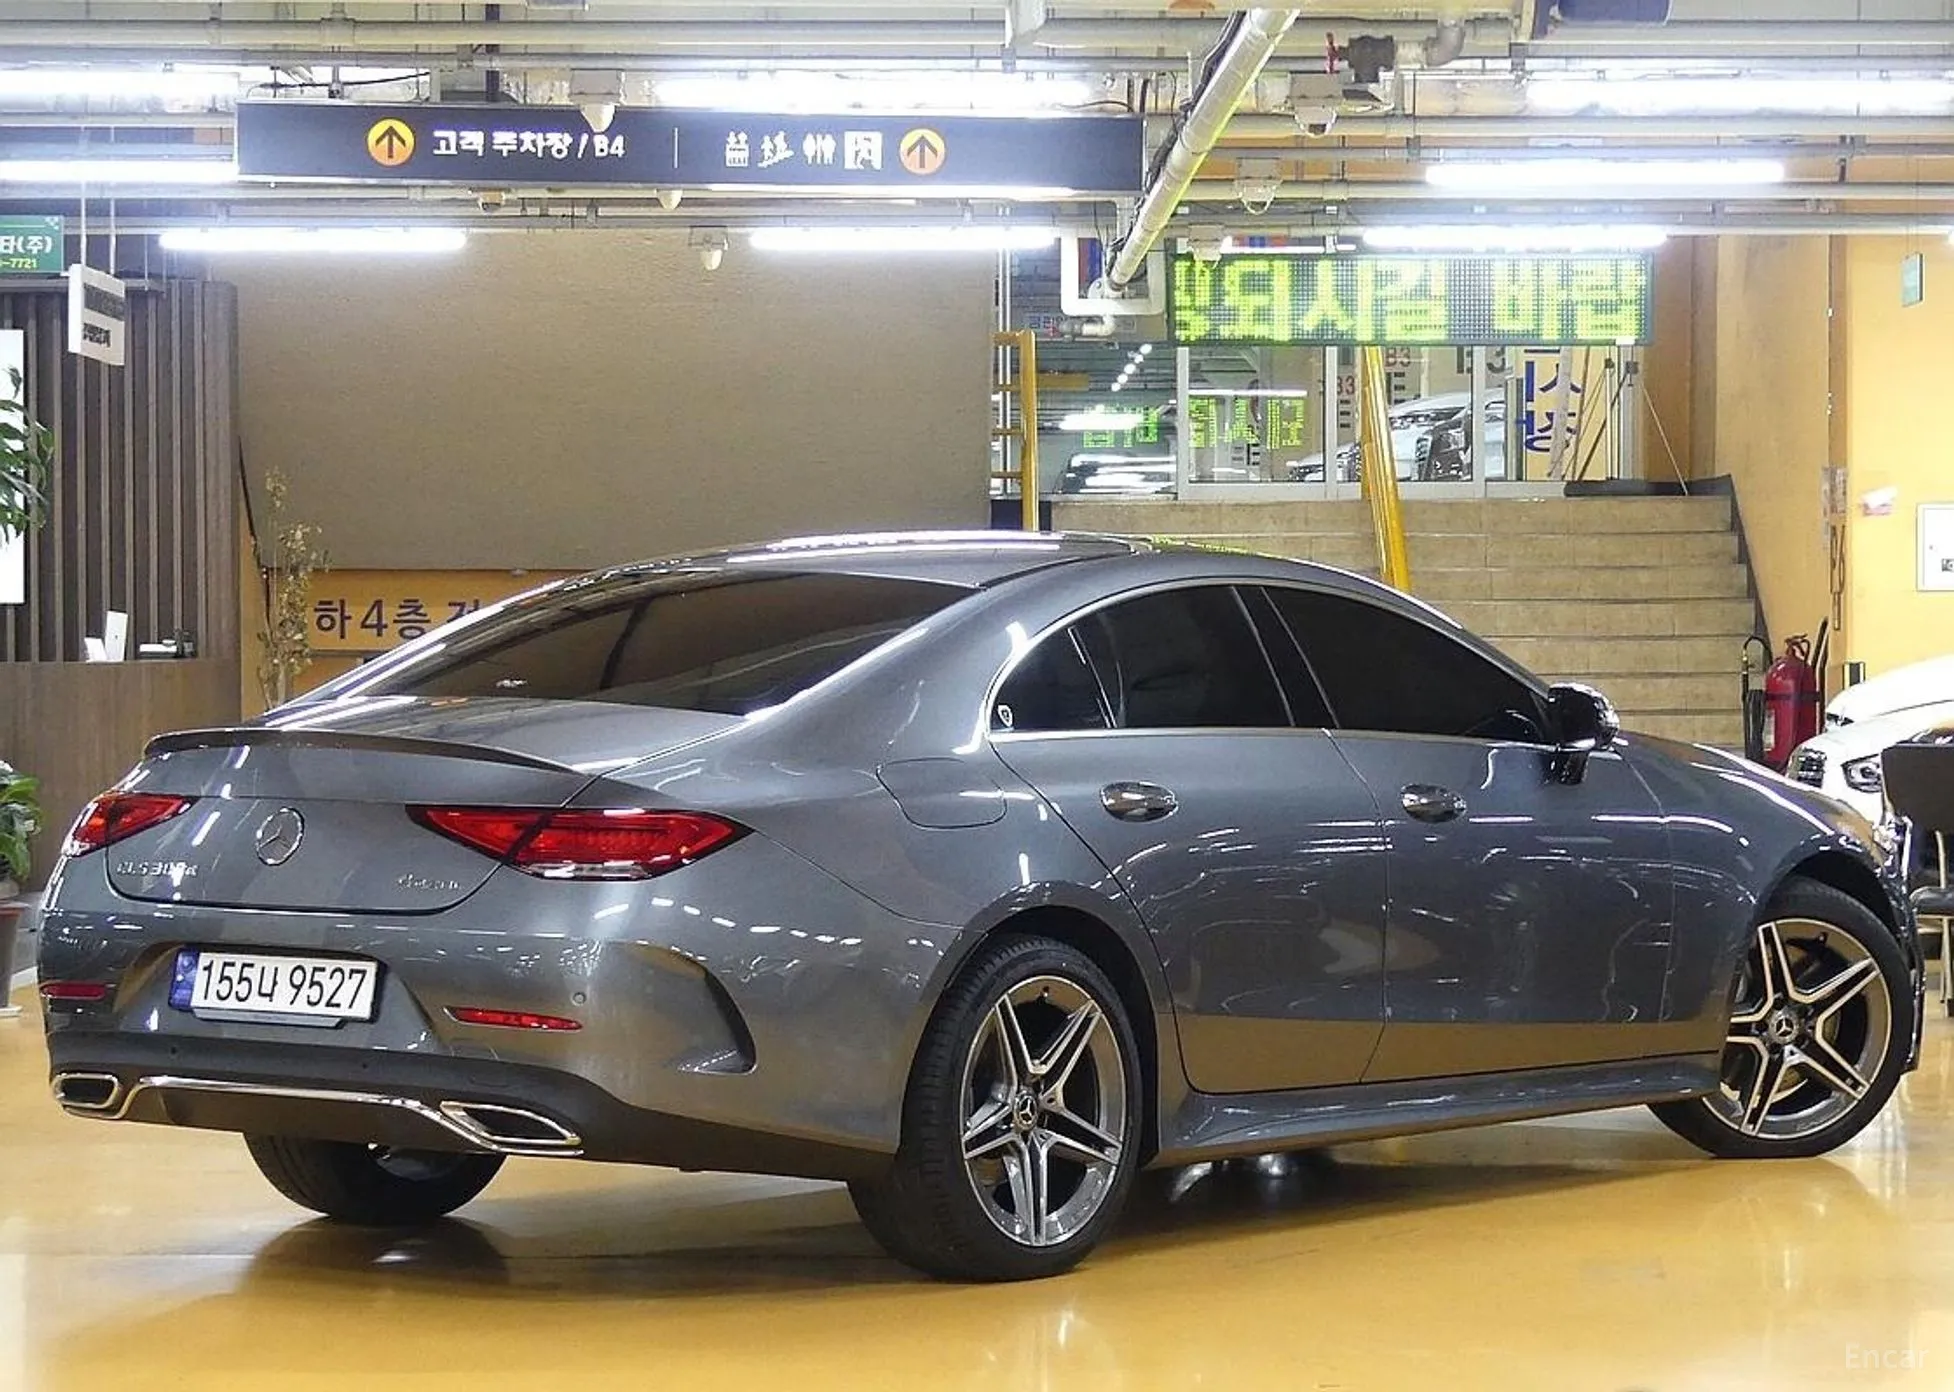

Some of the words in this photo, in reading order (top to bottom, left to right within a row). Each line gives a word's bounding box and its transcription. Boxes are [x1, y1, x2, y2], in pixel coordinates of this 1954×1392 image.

[432, 129, 485, 157] 고객
[491, 129, 574, 159] 주차장
[577, 132, 589, 159] /
[593, 134, 626, 158] B4
[202, 959, 279, 1003] 155나
[289, 964, 368, 1009] 9527
